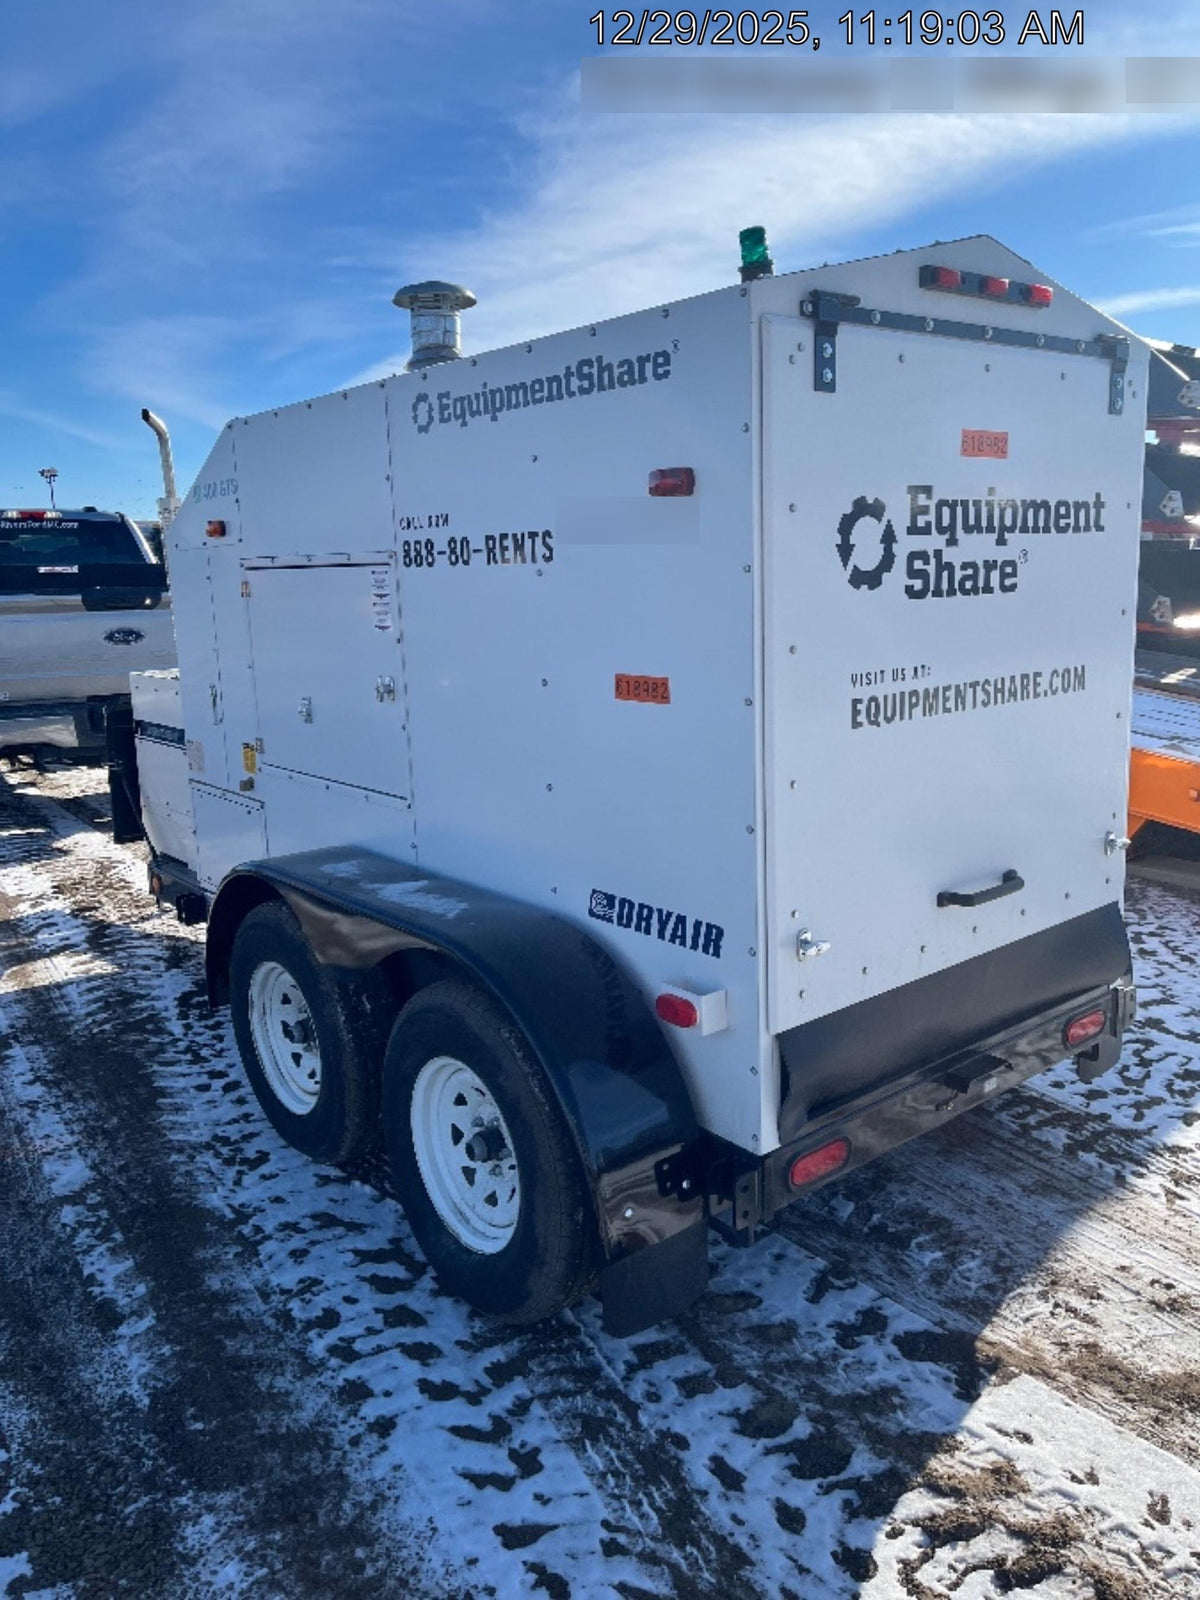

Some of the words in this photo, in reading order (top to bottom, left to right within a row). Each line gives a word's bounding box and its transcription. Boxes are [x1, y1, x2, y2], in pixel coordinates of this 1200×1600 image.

[437, 348, 672, 428] EquipmentShare
[400, 515, 424, 531] CALL
[906, 484, 1106, 548] Equipment
[402, 529, 554, 568] 888-80-RENTS
[904, 548, 1018, 600] Share
[850, 664, 1087, 730] EQUIPMENTSHARE.COM
[851, 669, 885, 688] VISIT
[892, 667, 906, 682] US
[615, 895, 725, 960] DRYAIR
